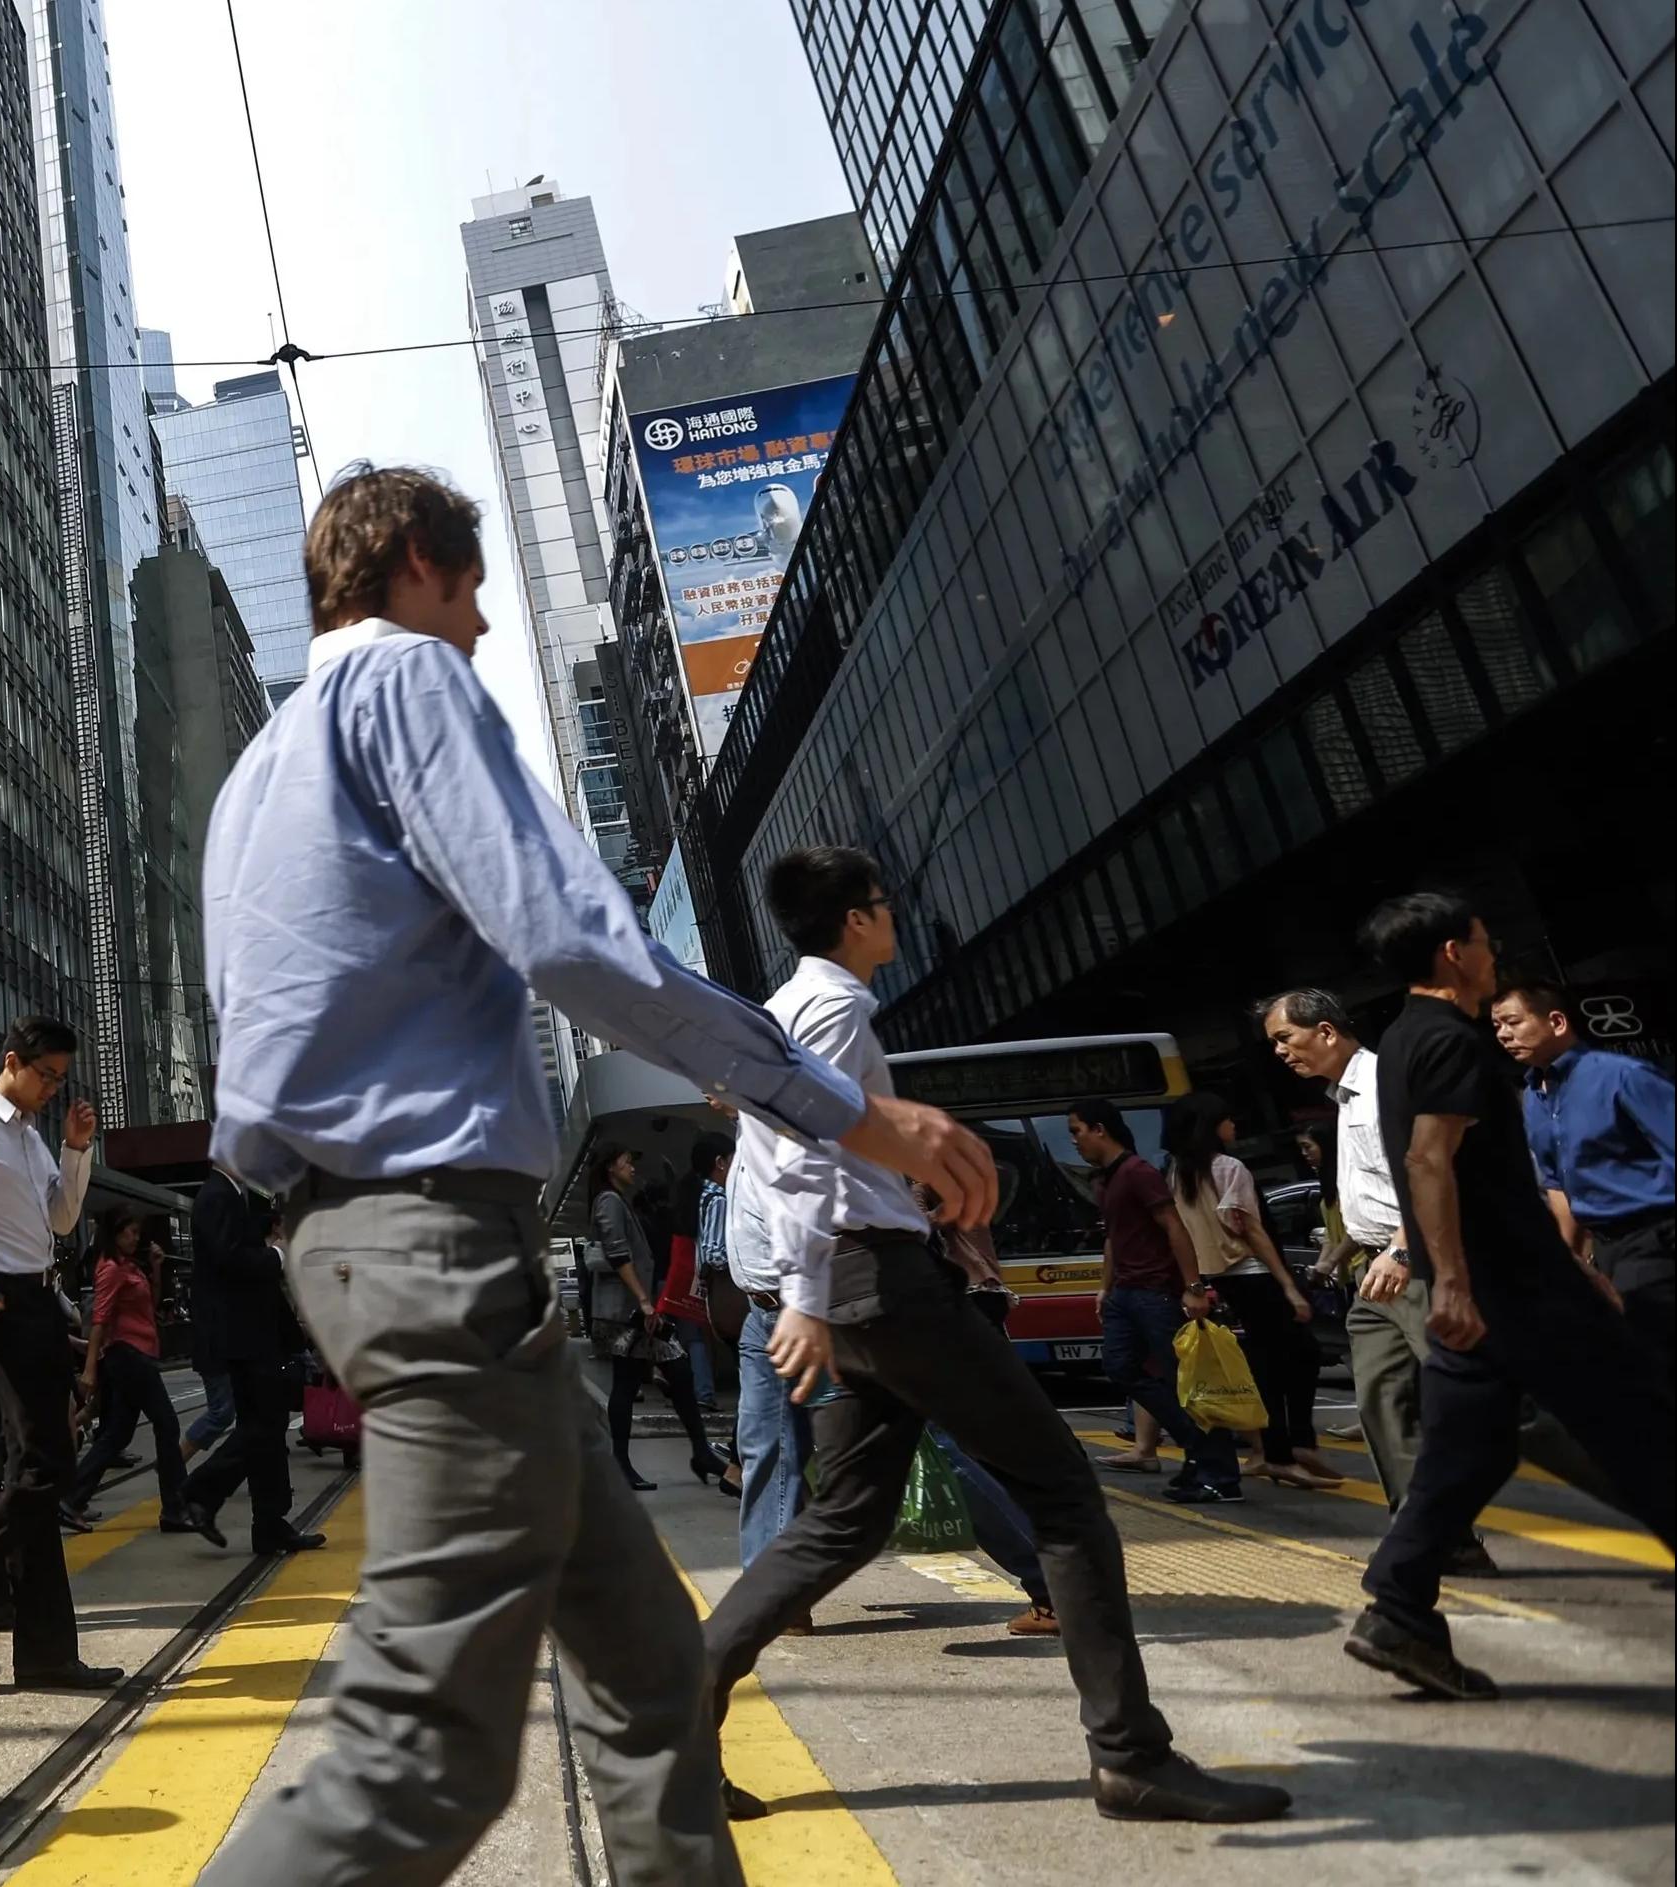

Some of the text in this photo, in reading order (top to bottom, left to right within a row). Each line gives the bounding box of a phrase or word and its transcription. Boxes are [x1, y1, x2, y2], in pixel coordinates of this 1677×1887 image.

[1210, 0, 1369, 219] servic
[685, 406, 755, 430] 海通國際
[689, 420, 758, 442] HAITONG
[763, 431, 837, 459] 融資專
[1181, 440, 1418, 690] KOREAN AIR
[1061, 1346, 1081, 1358] HV
